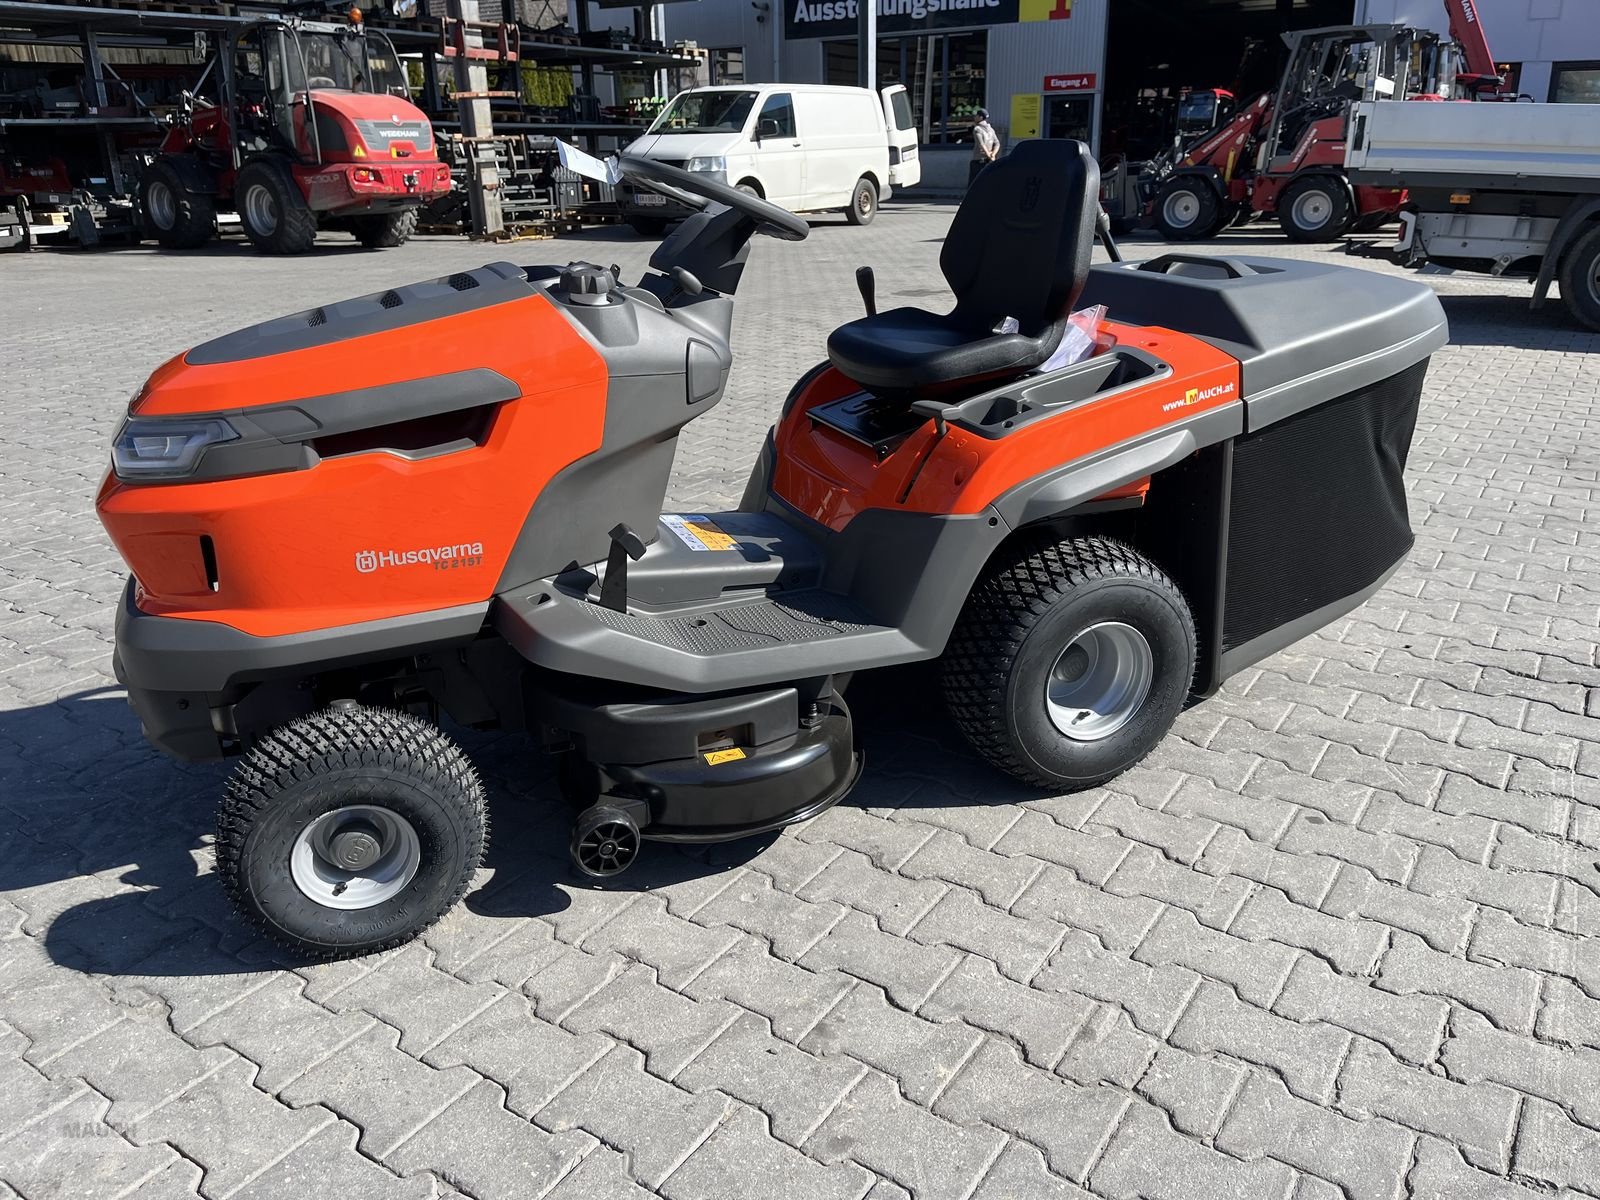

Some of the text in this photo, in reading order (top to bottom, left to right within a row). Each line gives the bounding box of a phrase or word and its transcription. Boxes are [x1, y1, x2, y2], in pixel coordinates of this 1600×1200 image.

[793, 0, 1000, 23] Ausstlungsa
[1050, 77, 1088, 88] Eingang A
[379, 130, 419, 138] WEIDEMANN
[1162, 382, 1234, 412] www.MAUCH.at
[378, 541, 483, 568] Husqvarna
[433, 556, 482, 571] TC 215T
